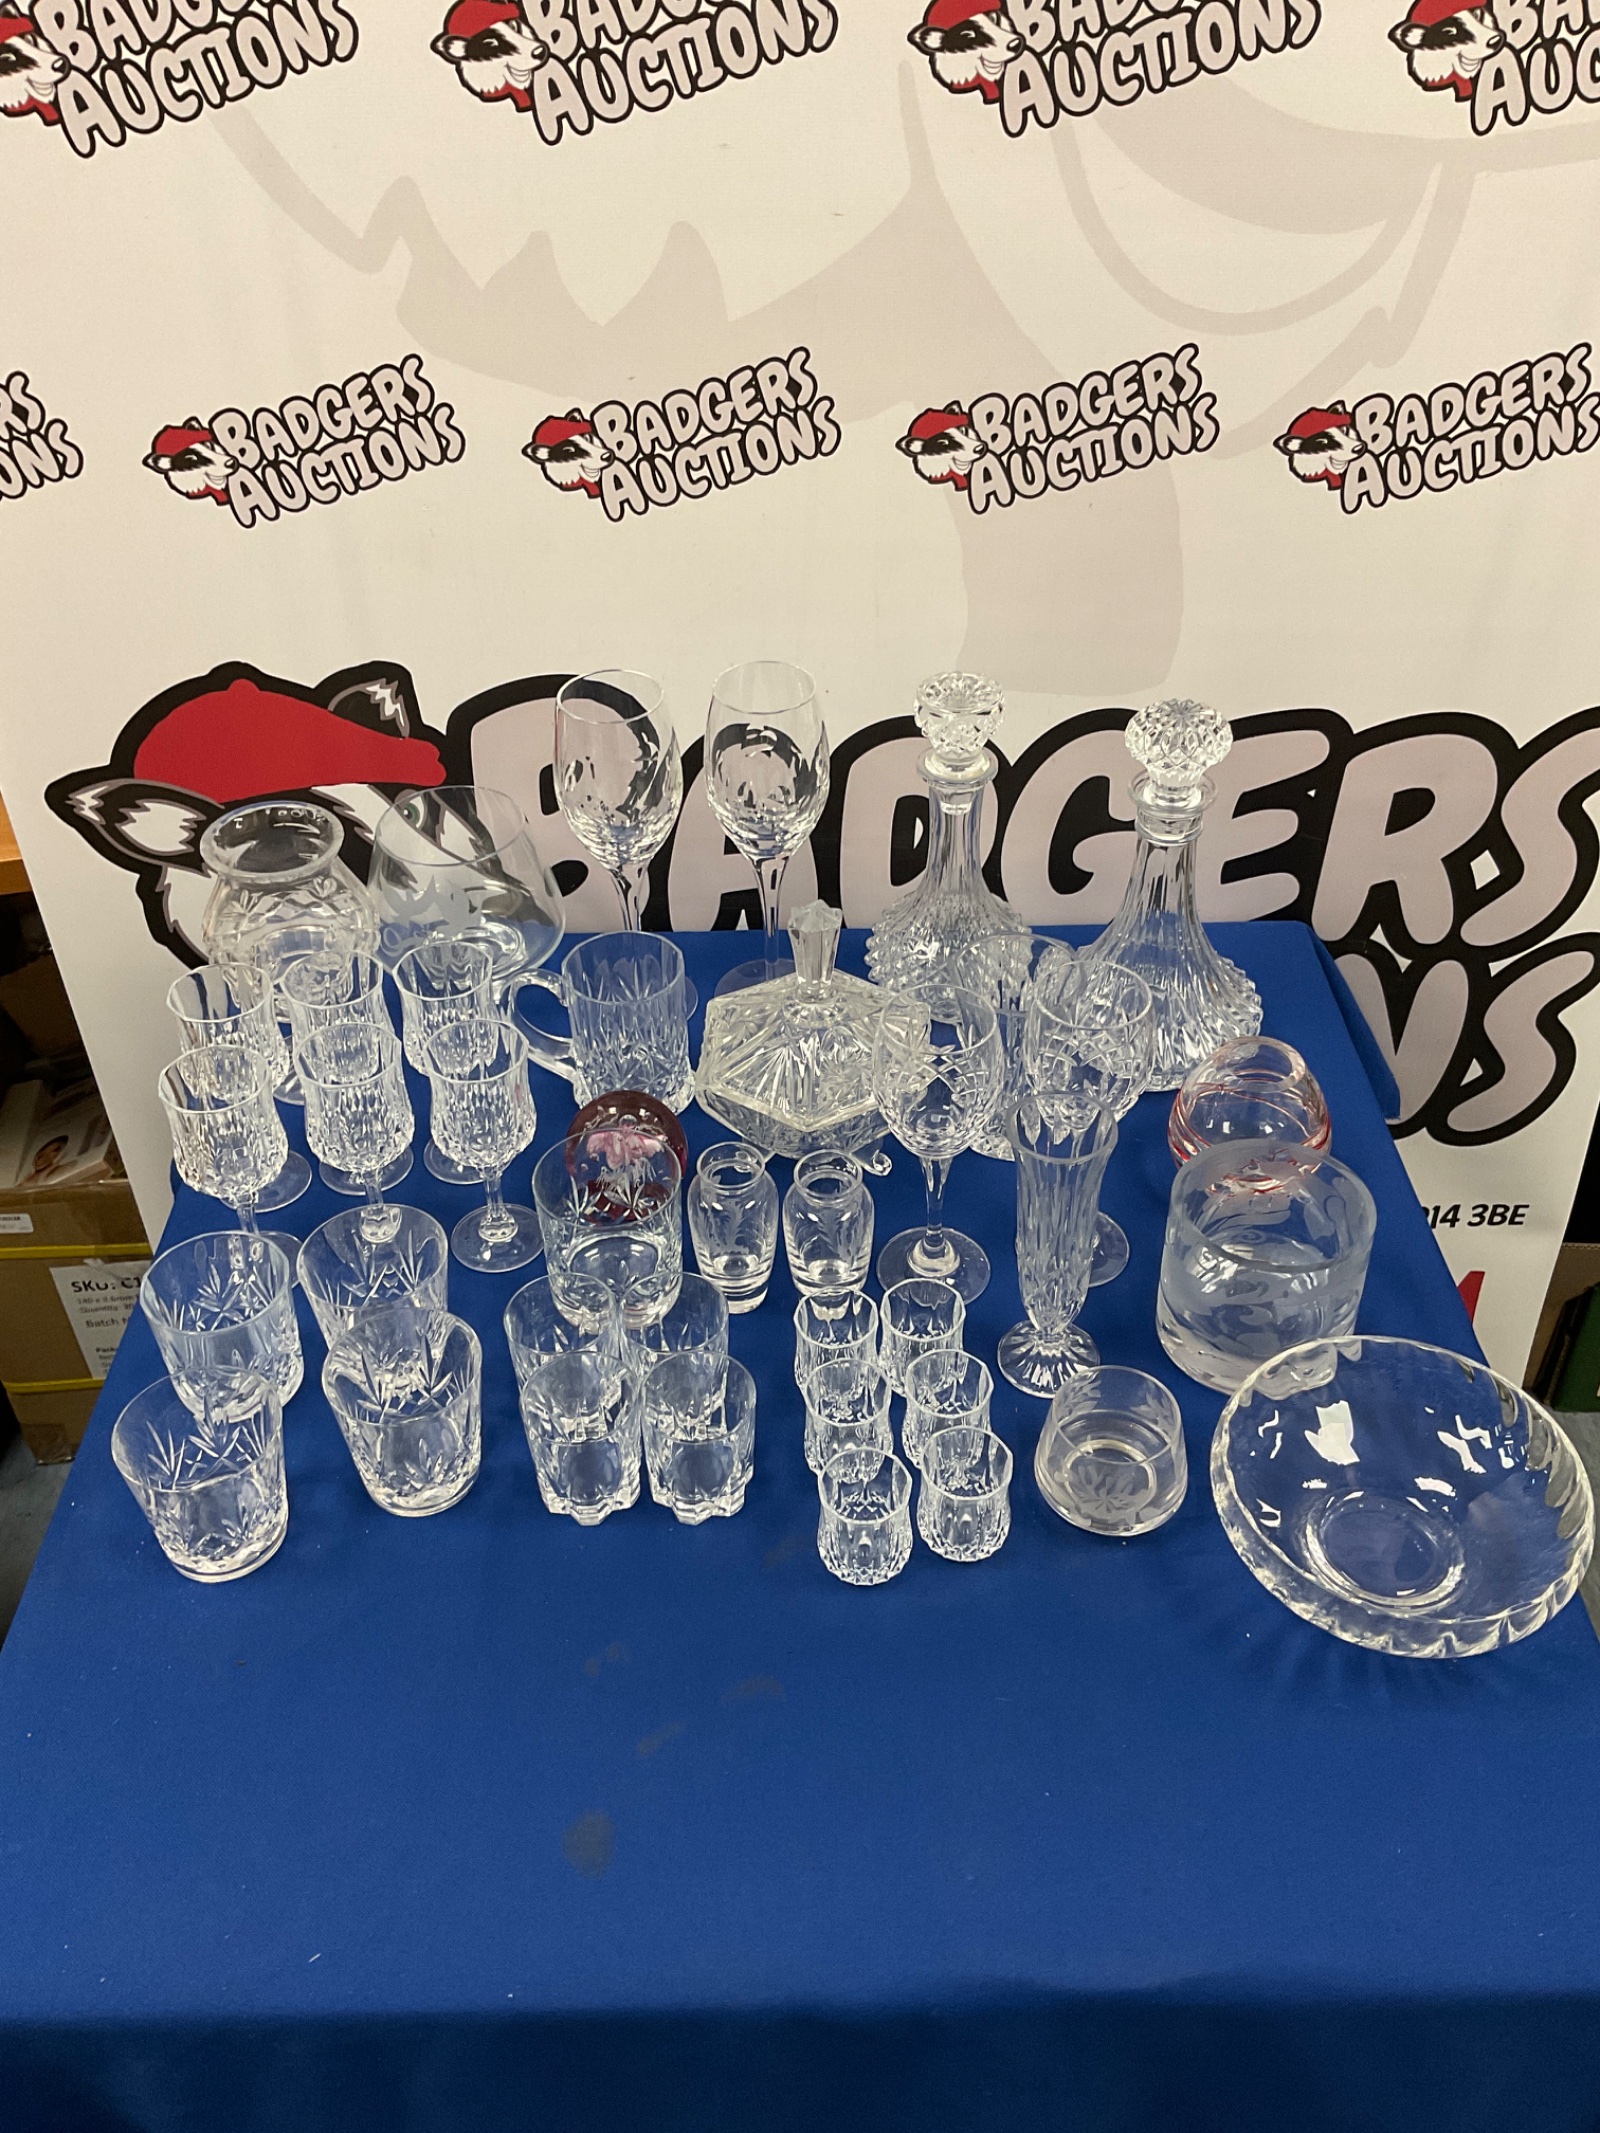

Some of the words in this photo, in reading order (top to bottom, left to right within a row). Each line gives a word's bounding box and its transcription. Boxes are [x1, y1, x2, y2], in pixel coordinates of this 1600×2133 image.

[57, 0, 359, 158] AUCTIONS
[209, 354, 434, 469] BADGERS
[591, 347, 817, 464] BADGERS
[601, 396, 841, 521] AUCTIONS
[968, 392, 1219, 515] AUCTIONS
[969, 343, 1202, 457] BADGERS
[1340, 391, 1600, 515] AUCTIONS
[1352, 342, 1592, 456] BADGERS
[227, 402, 466, 529] AUCTIONS
[1467, 1204, 1530, 1227] 3BE
